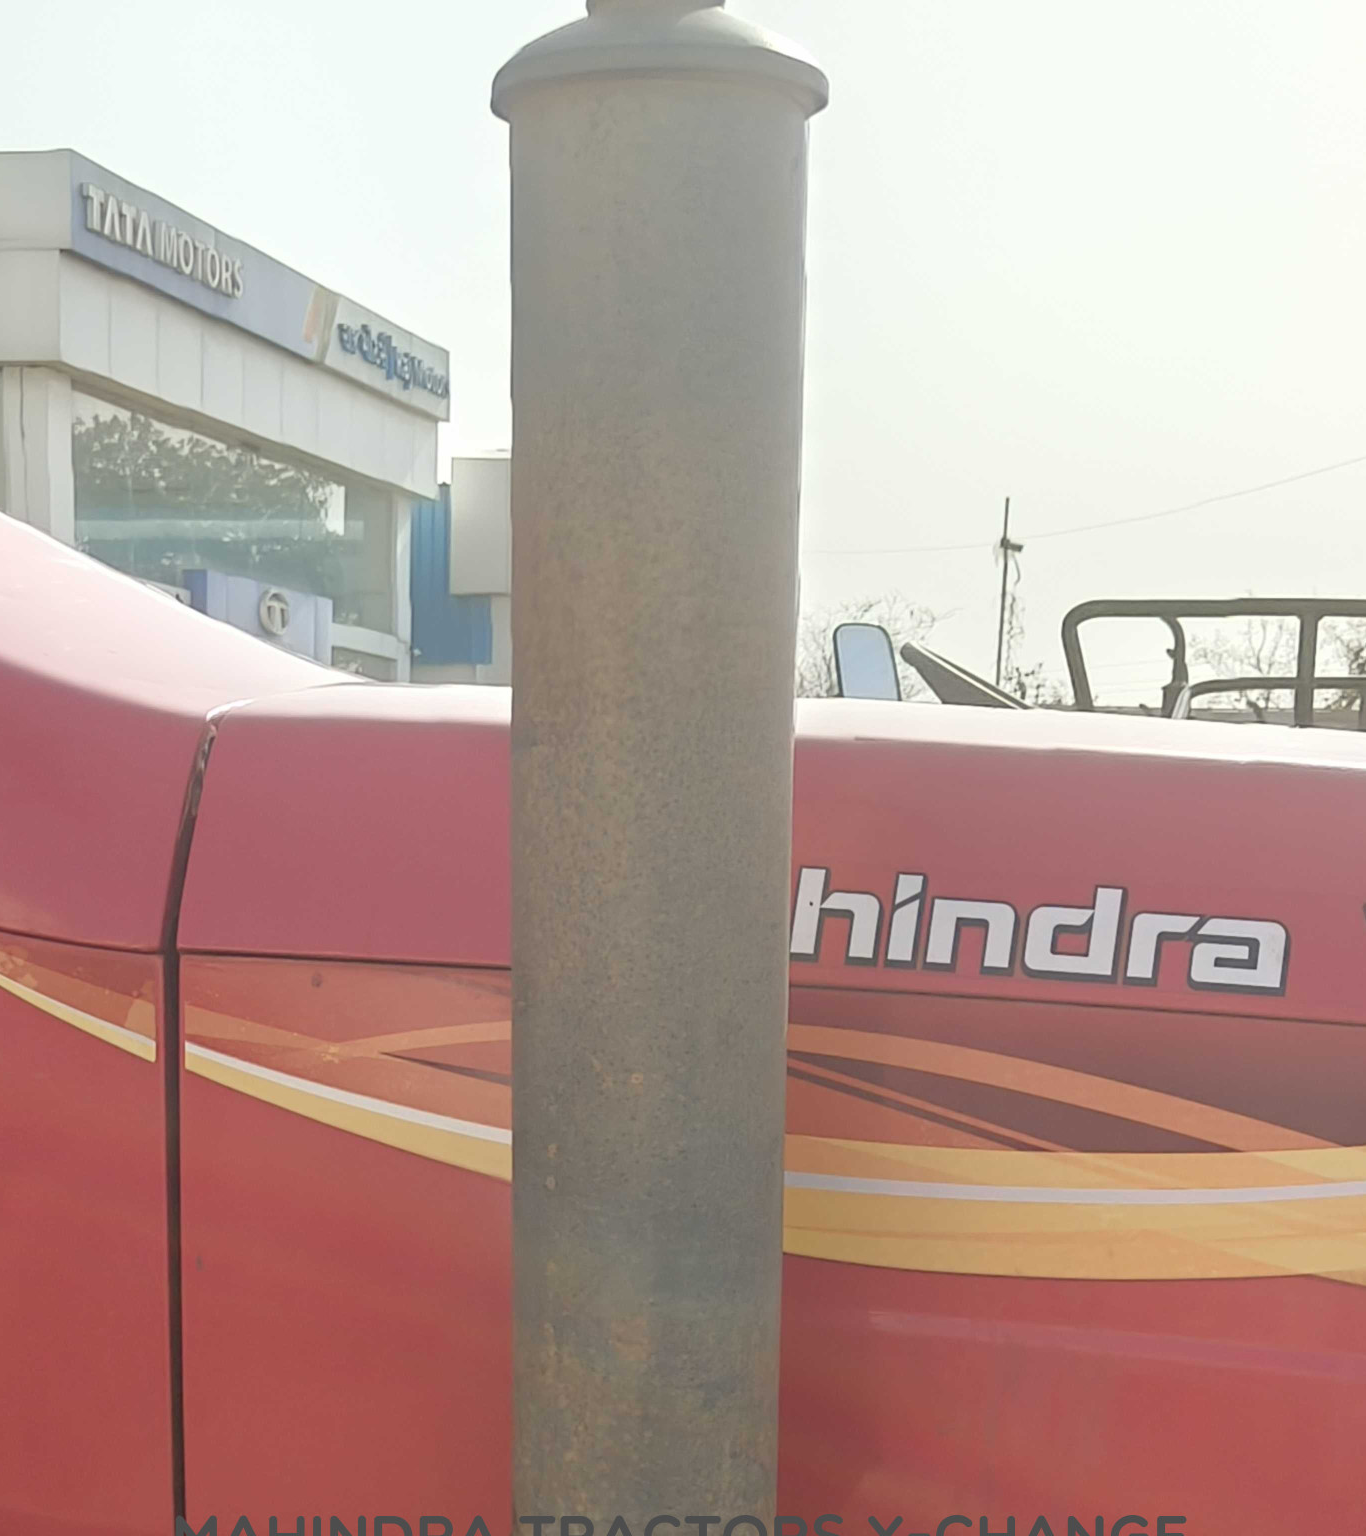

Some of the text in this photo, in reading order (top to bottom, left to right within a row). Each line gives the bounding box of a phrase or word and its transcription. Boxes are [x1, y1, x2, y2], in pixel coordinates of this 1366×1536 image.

[81, 183, 244, 299] TATA MOTORS
[789, 865, 1290, 997] hindra
